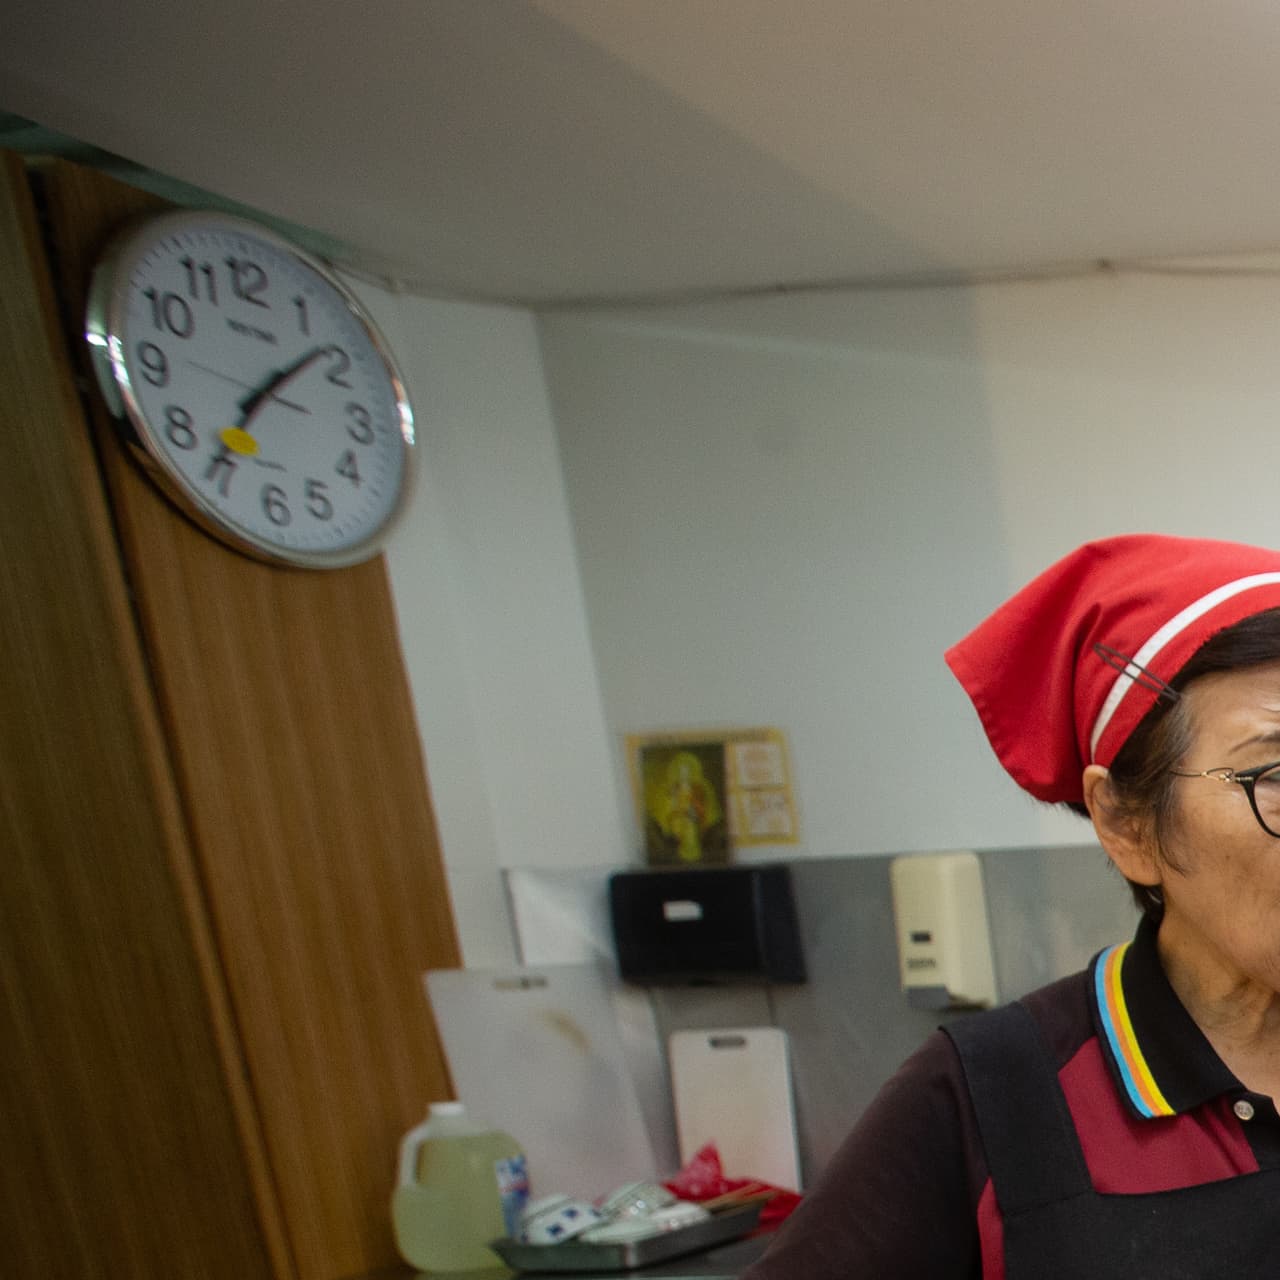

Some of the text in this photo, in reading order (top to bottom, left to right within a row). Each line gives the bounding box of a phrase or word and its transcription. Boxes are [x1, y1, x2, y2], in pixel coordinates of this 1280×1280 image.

[182, 257, 219, 306] 11
[224, 255, 271, 307] 12
[144, 287, 193, 339] 10
[294, 295, 310, 335] 1
[139, 342, 169, 387] 9
[326, 343, 353, 389] 2
[166, 406, 197, 450] 8
[346, 402, 375, 445] 3
[337, 449, 364, 488] 4
[262, 487, 292, 527] 6
[305, 478, 335, 521] 5
